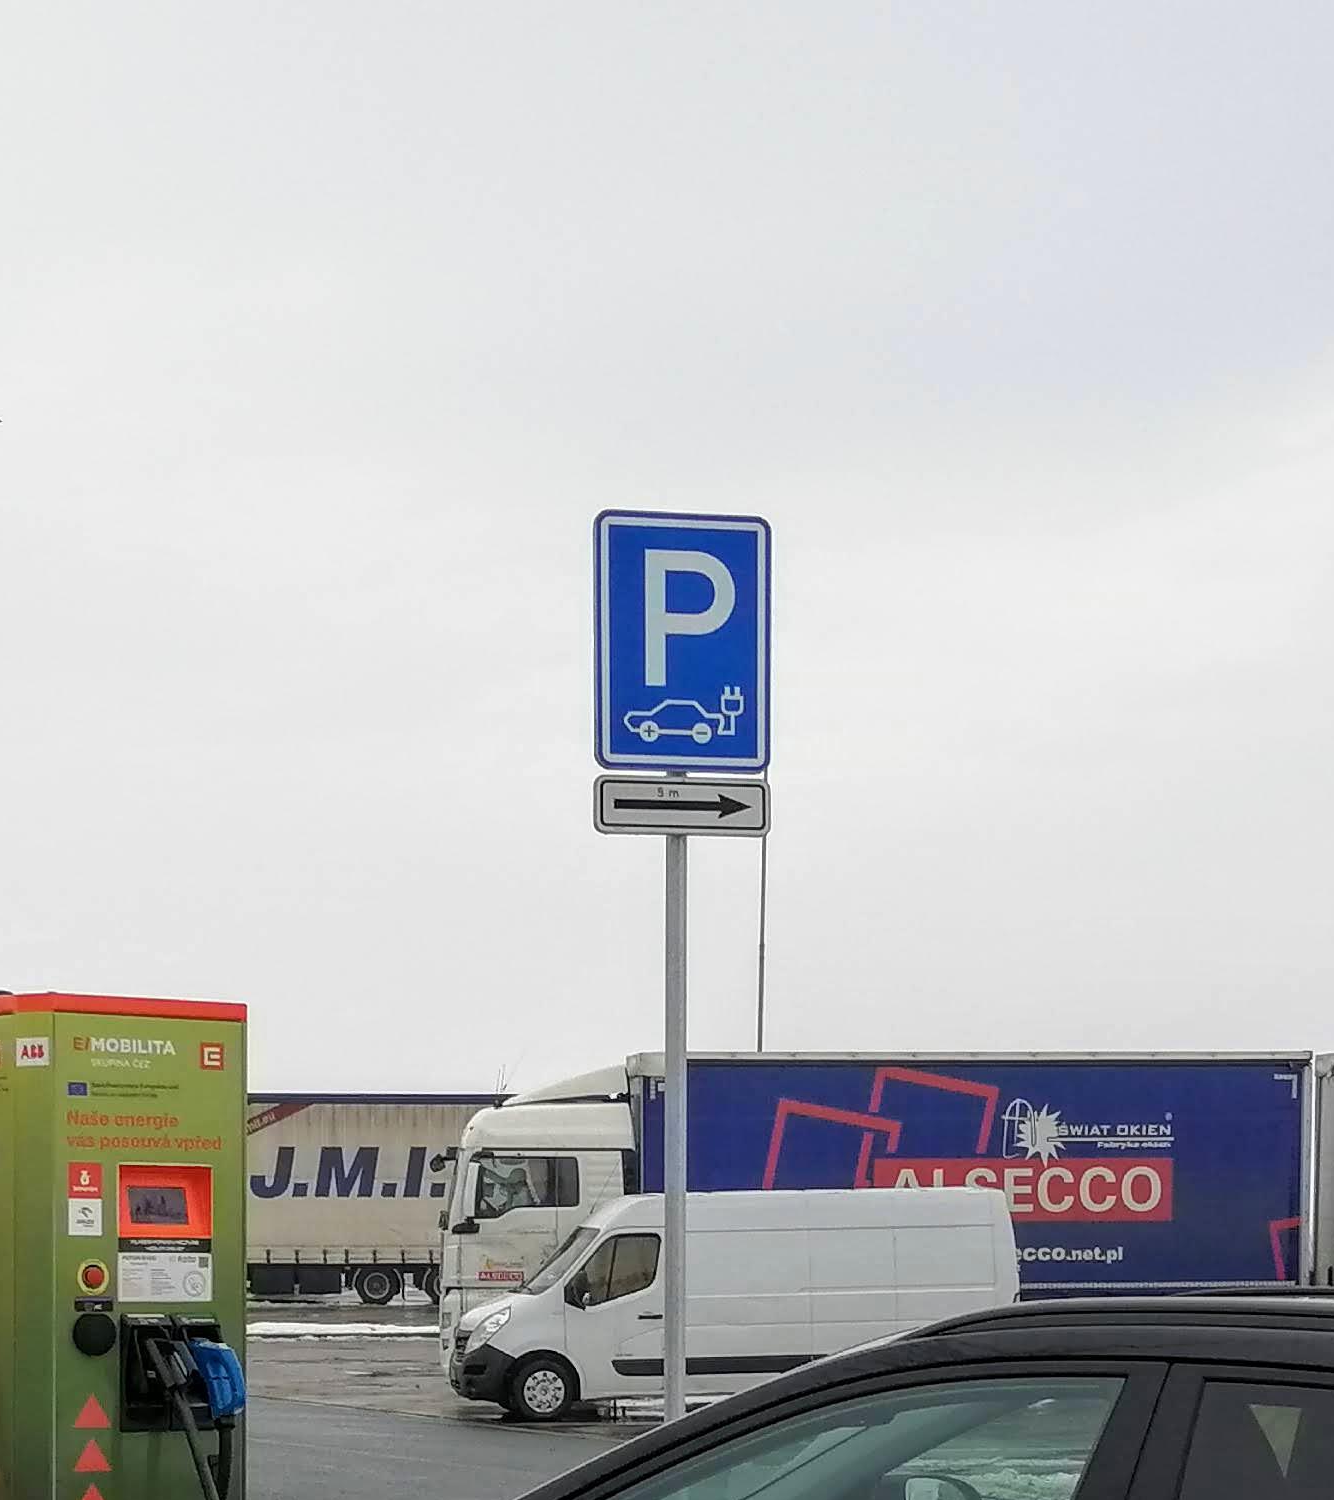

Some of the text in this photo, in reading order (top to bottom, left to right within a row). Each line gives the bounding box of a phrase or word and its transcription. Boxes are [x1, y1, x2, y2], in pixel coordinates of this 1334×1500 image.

[645, 549, 736, 686] P
[20, 1045, 45, 1058] ABB
[67, 1110, 180, 1130] Naše energie
[1116, 1124, 1172, 1136] OKIEN
[249, 1146, 460, 1198] J.M.I.
